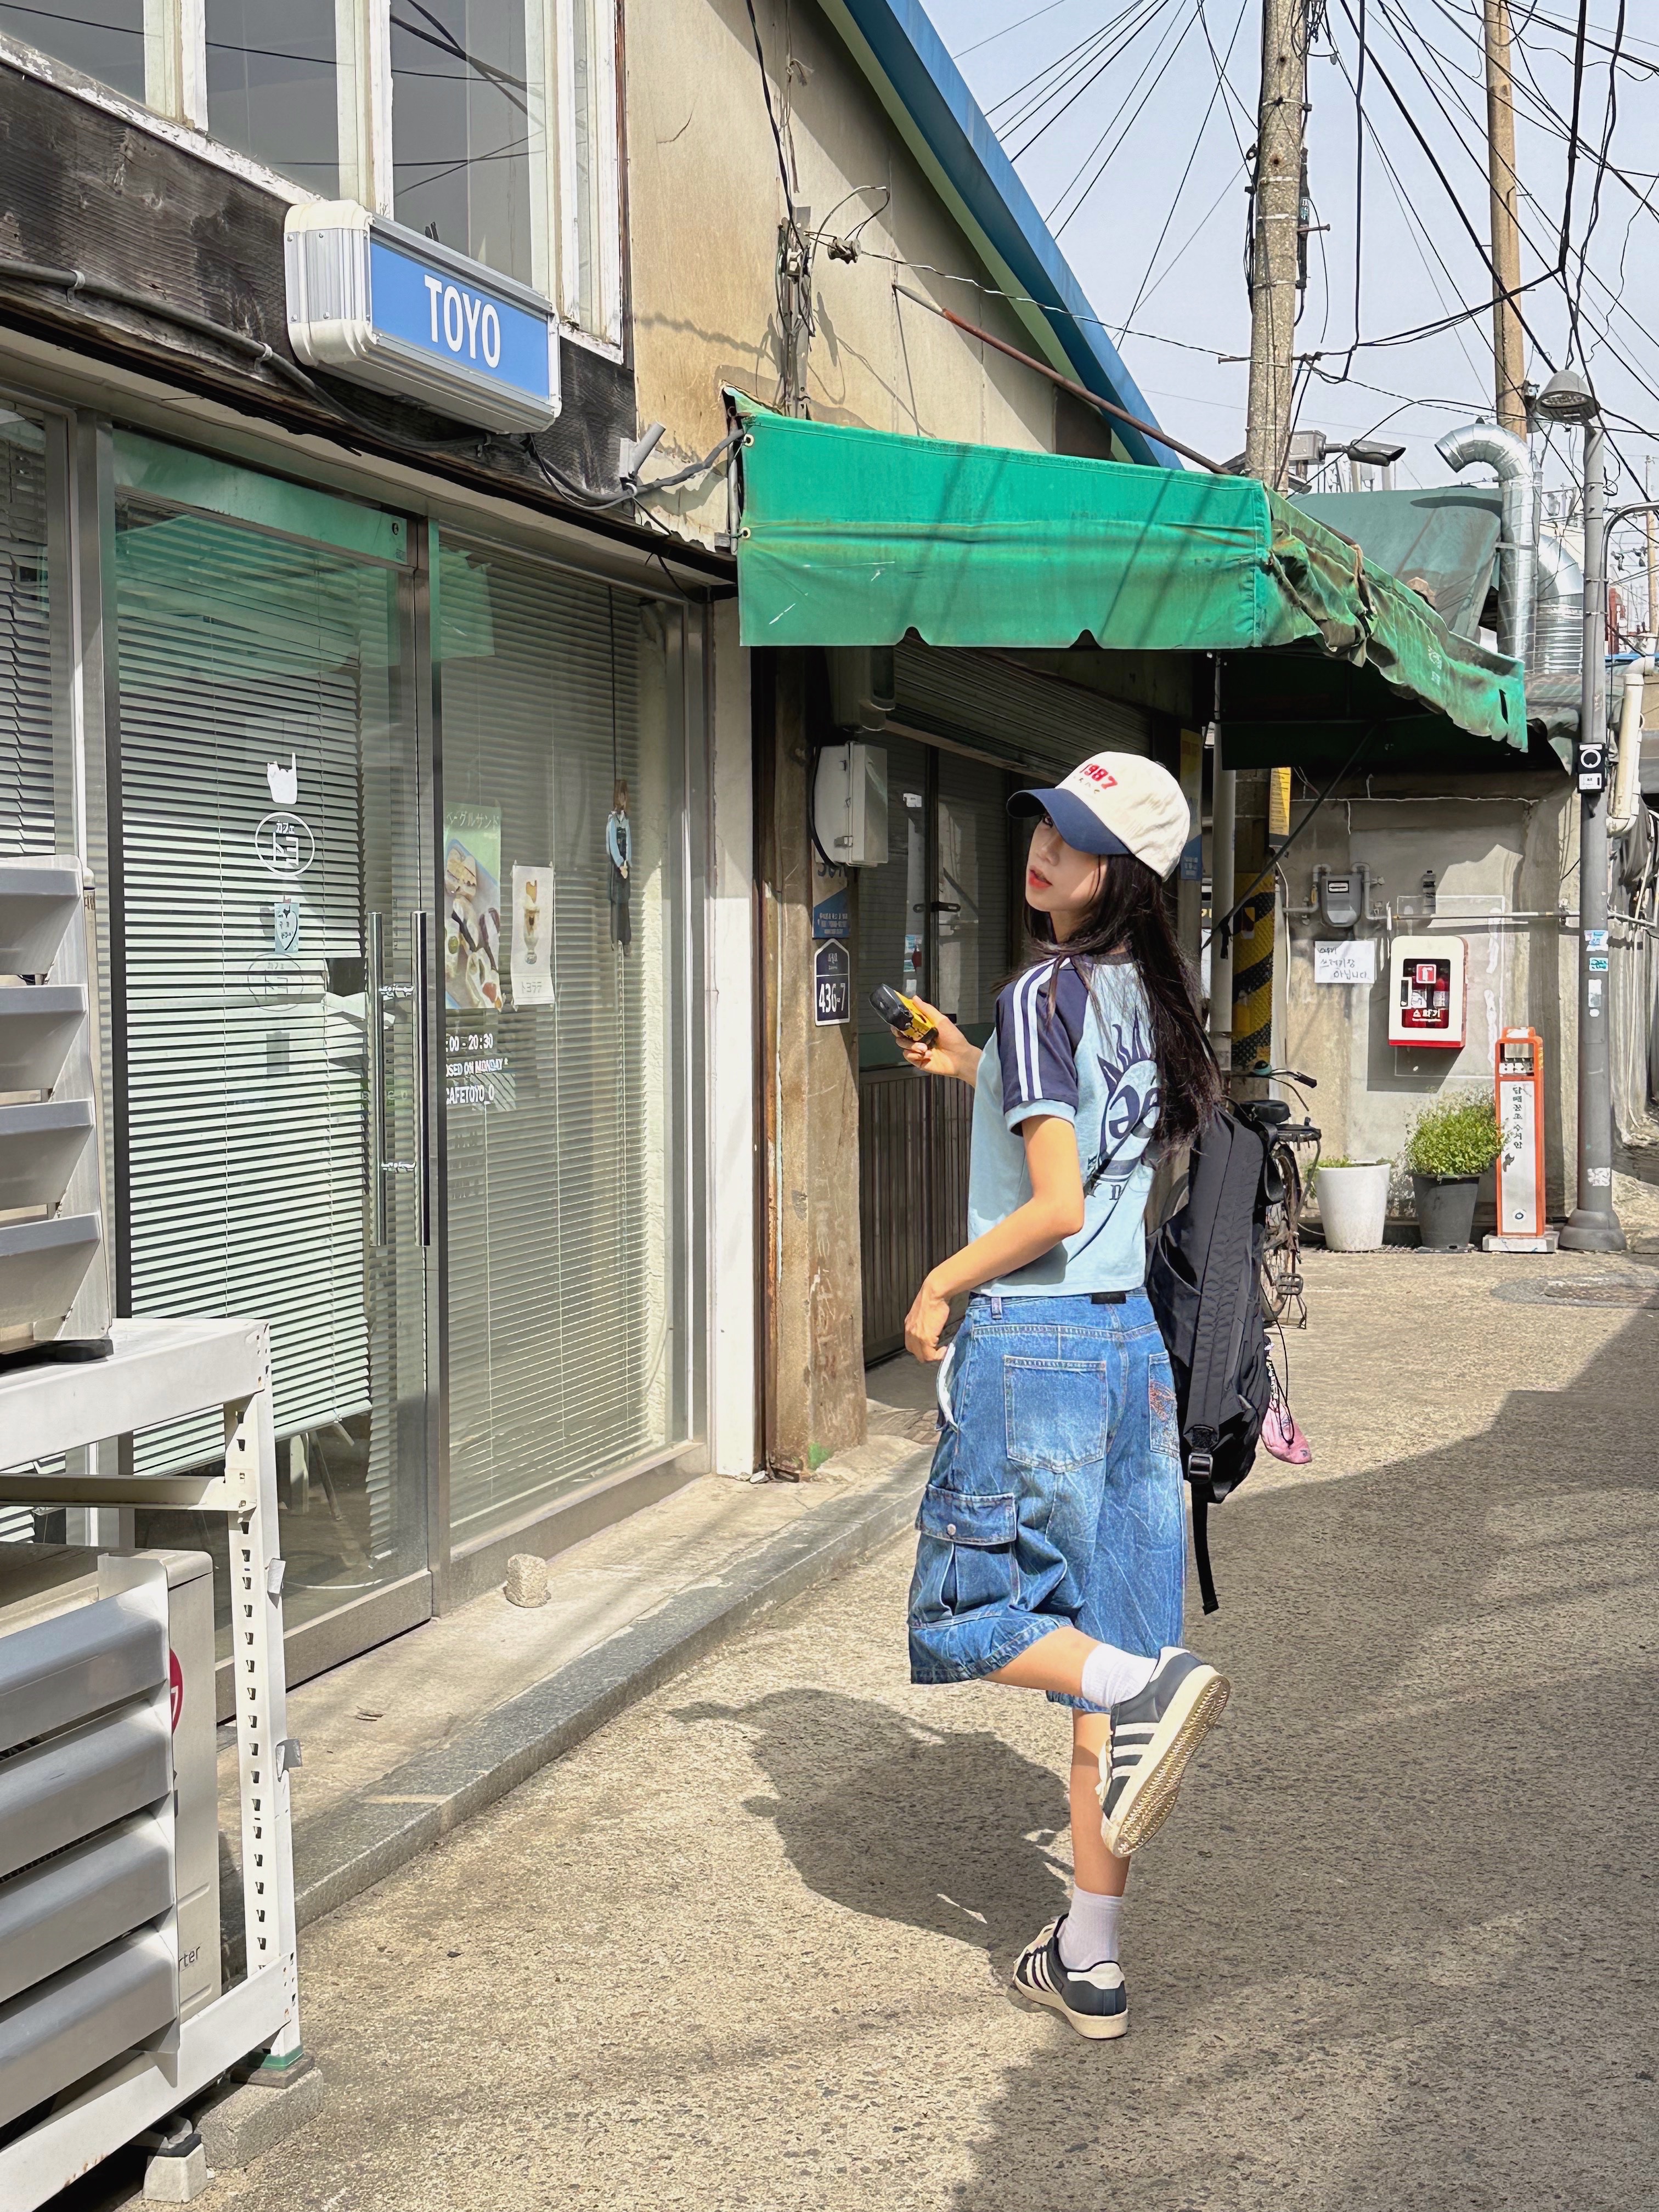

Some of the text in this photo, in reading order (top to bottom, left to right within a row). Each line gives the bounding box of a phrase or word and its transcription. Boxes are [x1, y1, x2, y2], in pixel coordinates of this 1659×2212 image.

[424, 274, 501, 368] TOYO
[1079, 763, 1118, 789] 1987
[818, 983, 846, 1013] 436-7
[468, 1033, 494, 1050] 20:30
[464, 1062, 474, 1075] ON
[475, 1058, 504, 1074] MONDAY
